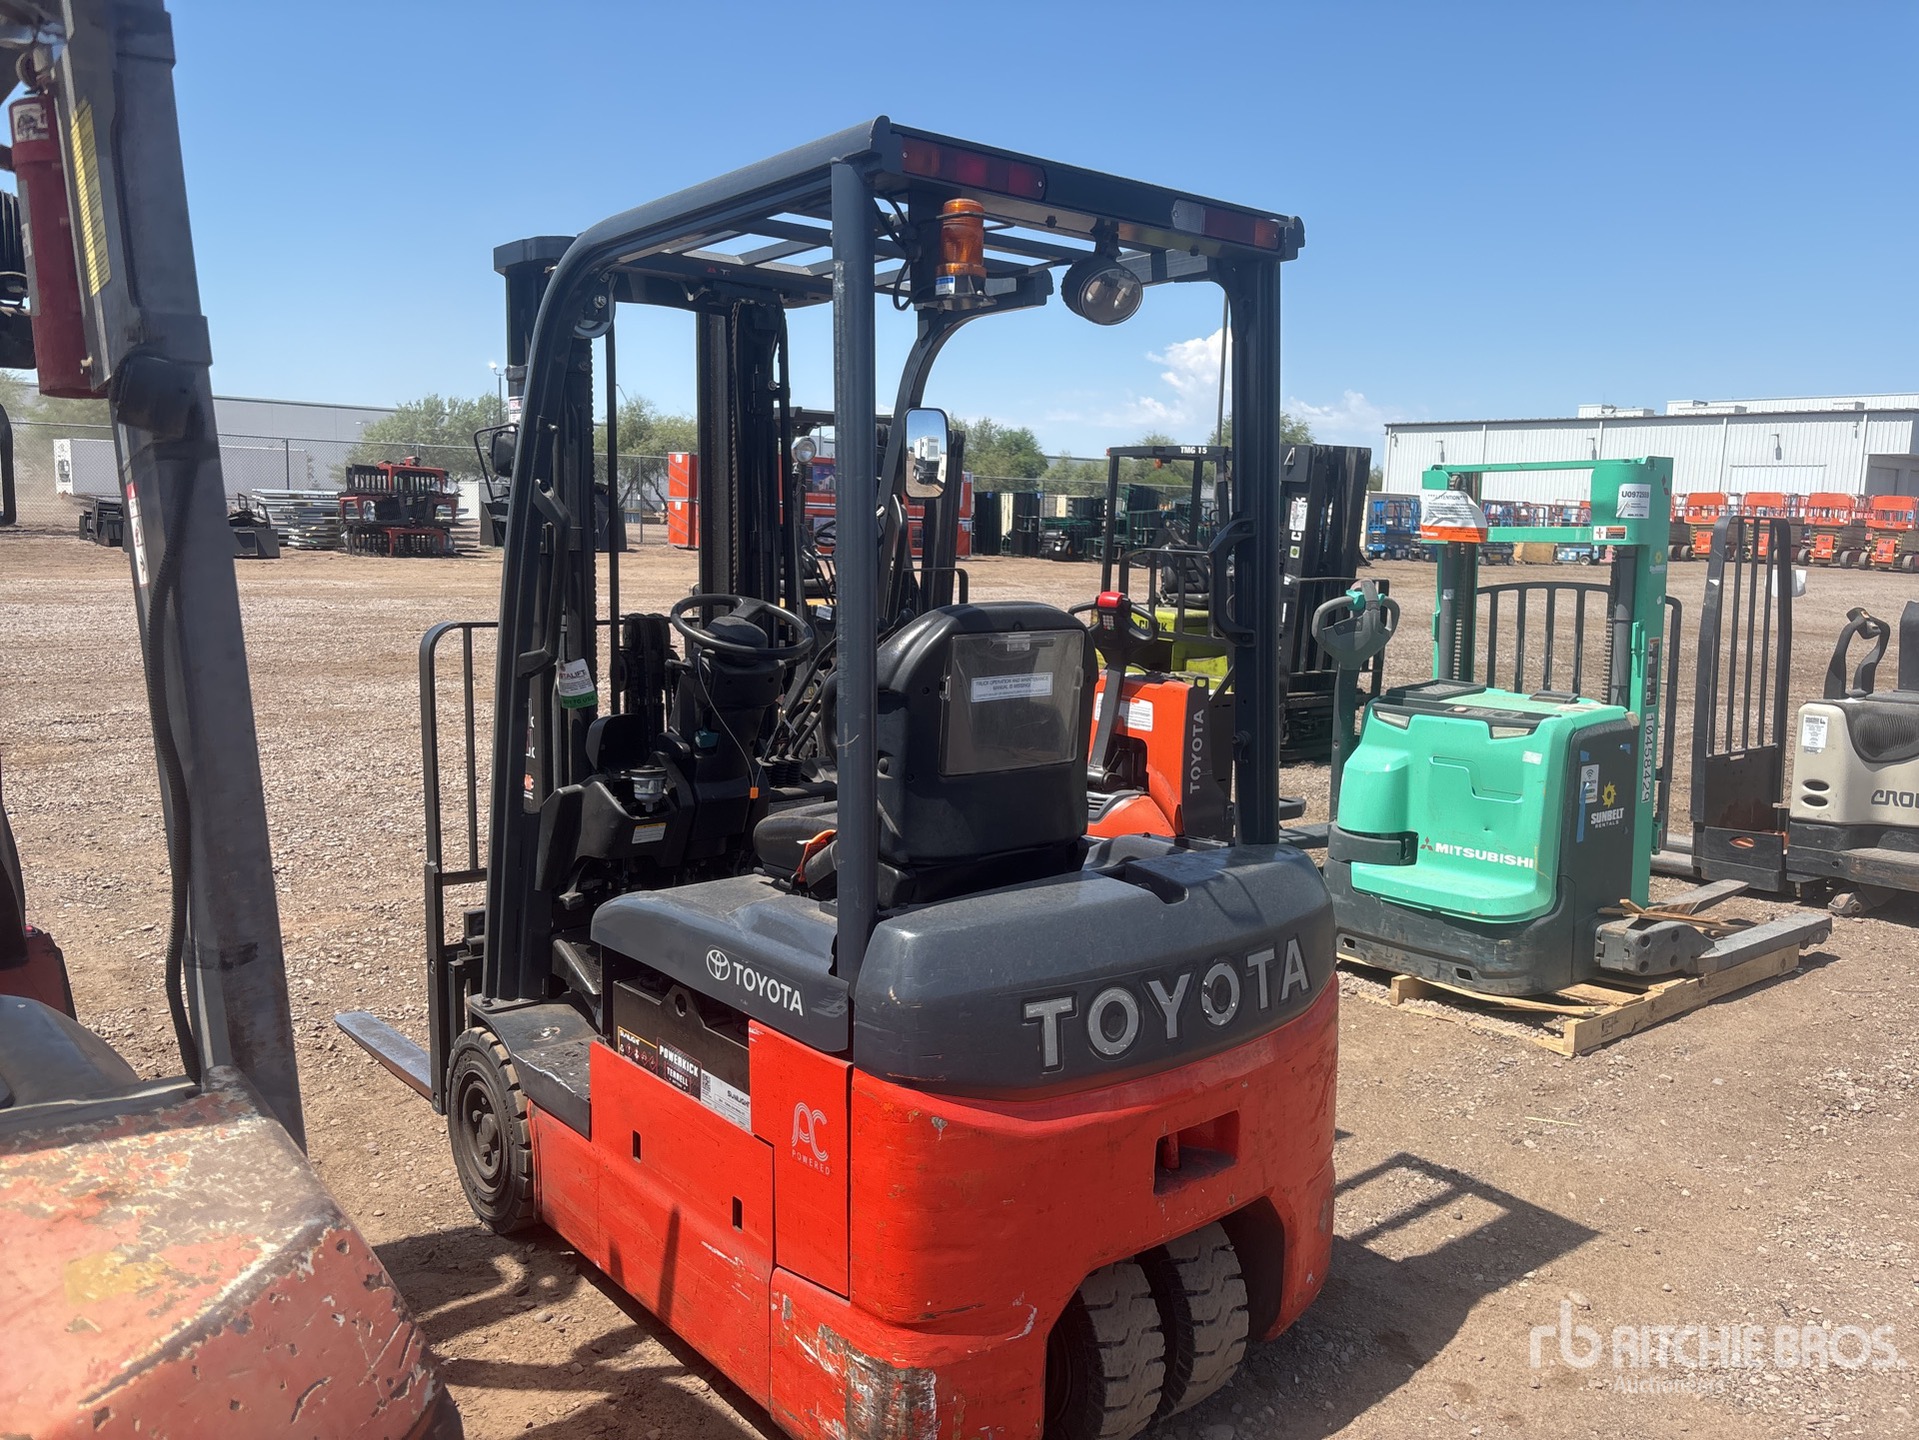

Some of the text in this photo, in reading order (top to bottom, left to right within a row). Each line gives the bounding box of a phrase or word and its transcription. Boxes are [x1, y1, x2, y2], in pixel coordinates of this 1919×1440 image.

[1180, 446, 1208, 454] TMG 15
[1189, 709, 1204, 794] TOYOTA
[1642, 714, 1655, 803] 10458429
[1590, 808, 1625, 825] SUNBELT
[1594, 820, 1619, 829] RENTALS
[1435, 842, 1534, 869] MITSUBISHI
[732, 961, 804, 1017] TOYOTA
[1024, 938, 1311, 1067] TOYOTA
[659, 1044, 699, 1078] POWERKICK
[791, 1149, 830, 1175] POWERED
